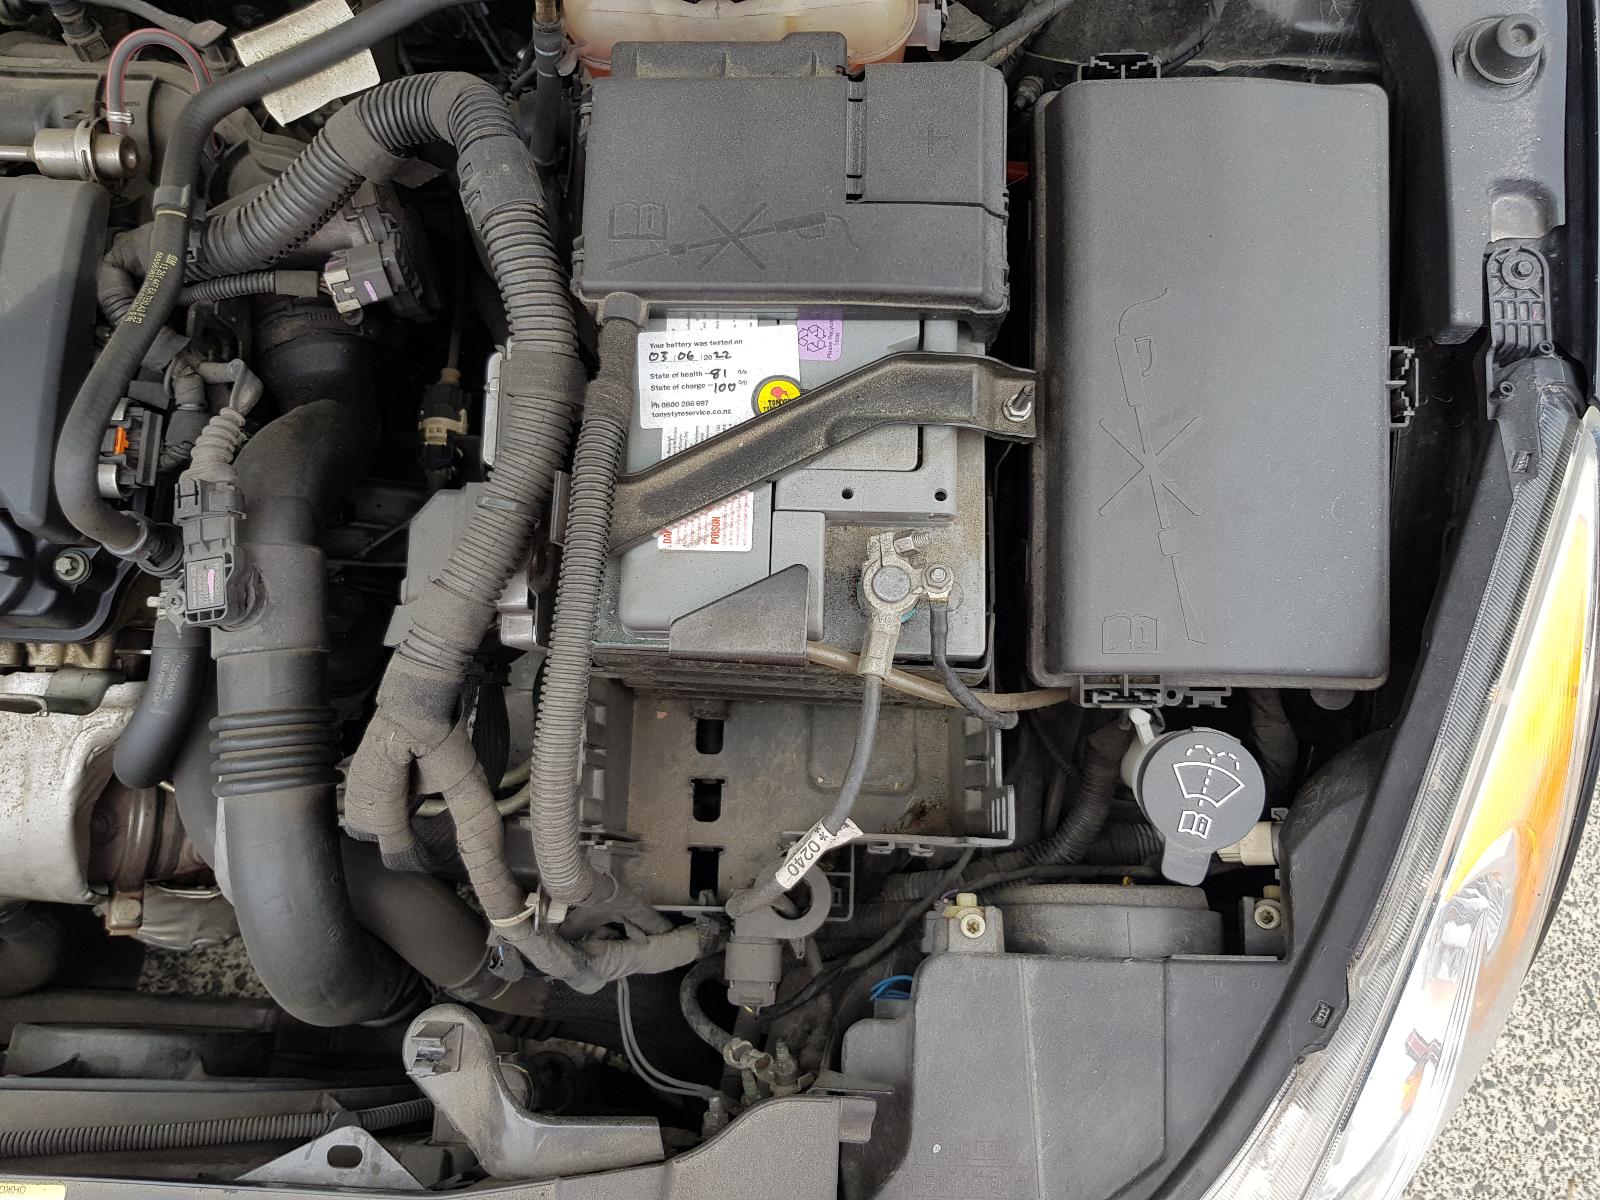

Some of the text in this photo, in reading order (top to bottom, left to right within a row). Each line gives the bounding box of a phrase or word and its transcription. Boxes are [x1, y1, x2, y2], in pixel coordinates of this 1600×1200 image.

[651, 401, 660, 409] Ph
[651, 409, 732, 418] tonystyreservice.co.nz
[711, 516, 721, 545] POISON
